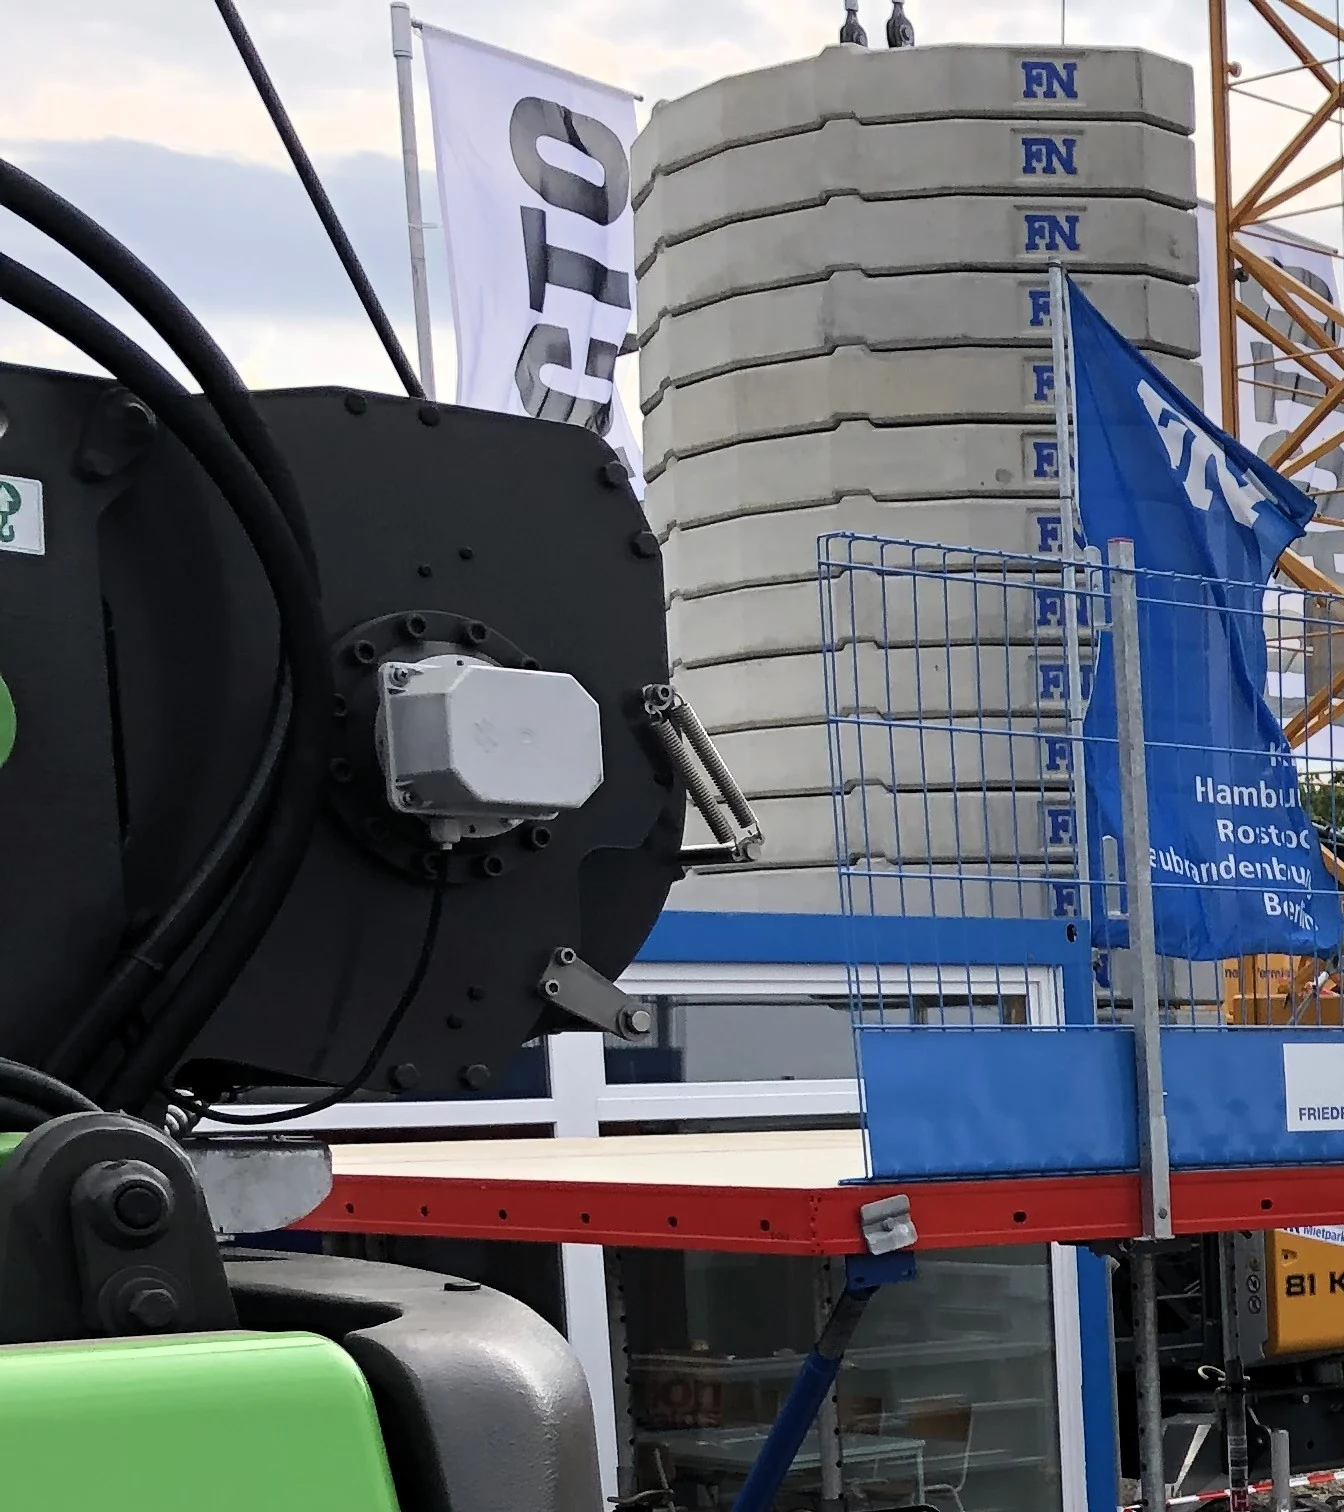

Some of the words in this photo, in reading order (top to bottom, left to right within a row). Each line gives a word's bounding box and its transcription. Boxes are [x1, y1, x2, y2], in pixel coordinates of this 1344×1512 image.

[1021, 61, 1078, 99] FN
[1021, 138, 1078, 174] FN
[1024, 214, 1081, 251] FN
[1029, 290, 1052, 327] F
[1216, 818, 1311, 850] Rostoc
